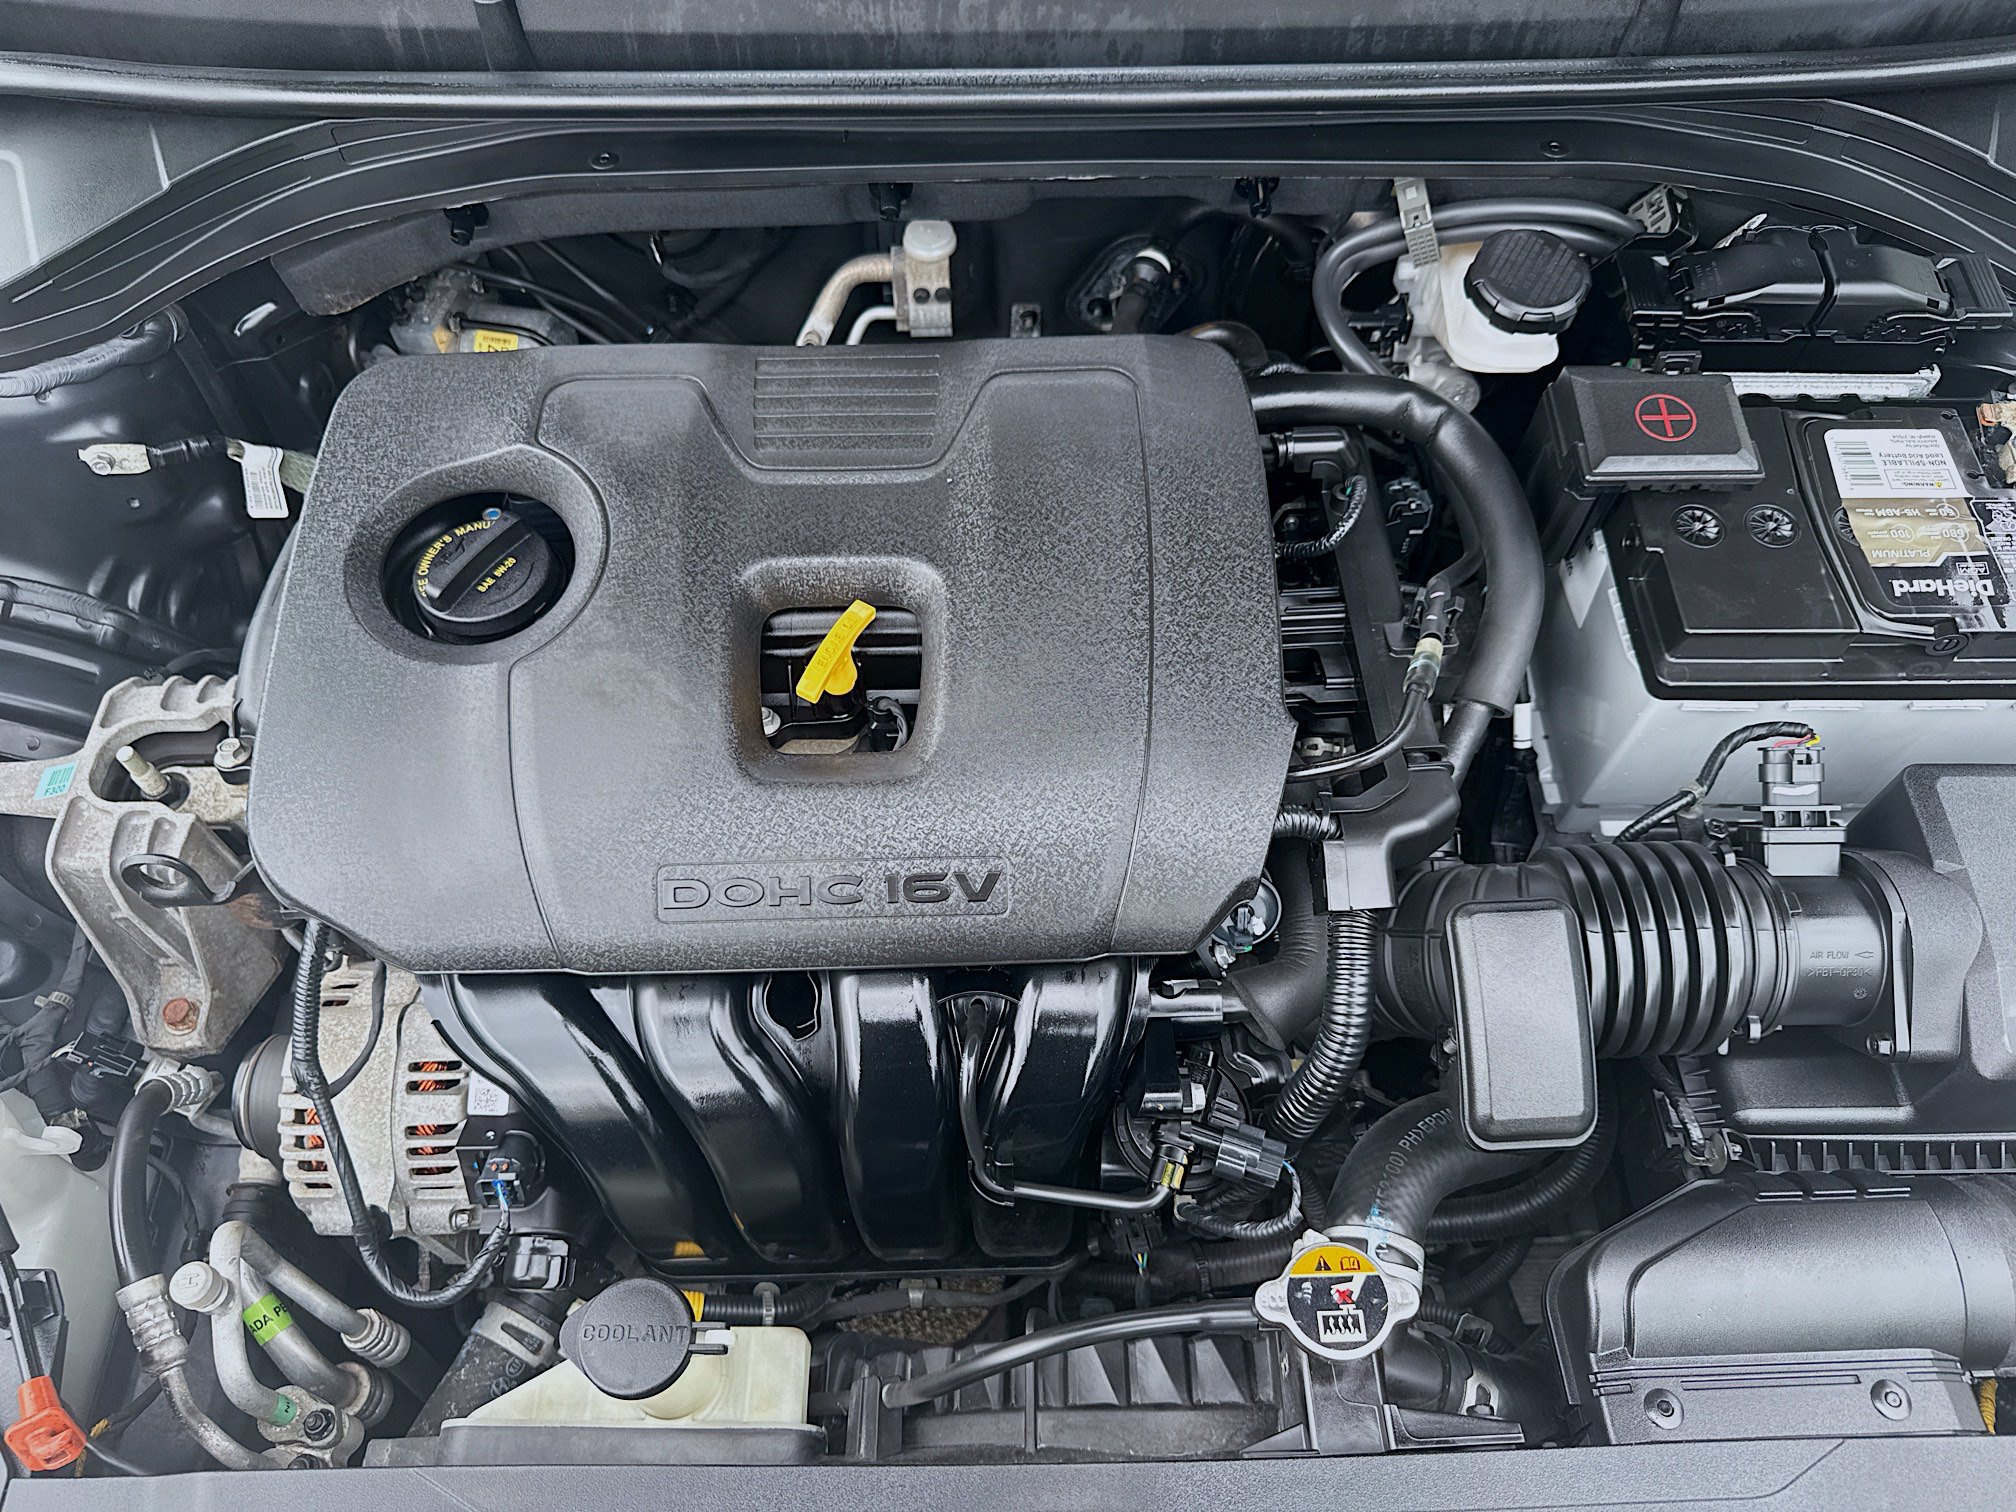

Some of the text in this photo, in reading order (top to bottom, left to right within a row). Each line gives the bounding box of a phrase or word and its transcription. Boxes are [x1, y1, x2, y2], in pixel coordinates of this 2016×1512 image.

[1890, 529, 1911, 538] 100
[418, 535, 453, 576] OWNER'S
[1871, 548, 1931, 558] PLATINUM
[476, 557, 517, 593] SAE 5W-20
[816, 633, 846, 668] ENGINE
[44, 784, 66, 796] F300
[663, 871, 1002, 910] DOHC 16V
[1810, 950, 1850, 960] AIR FLOW
[583, 1324, 688, 1342] COOLANT
